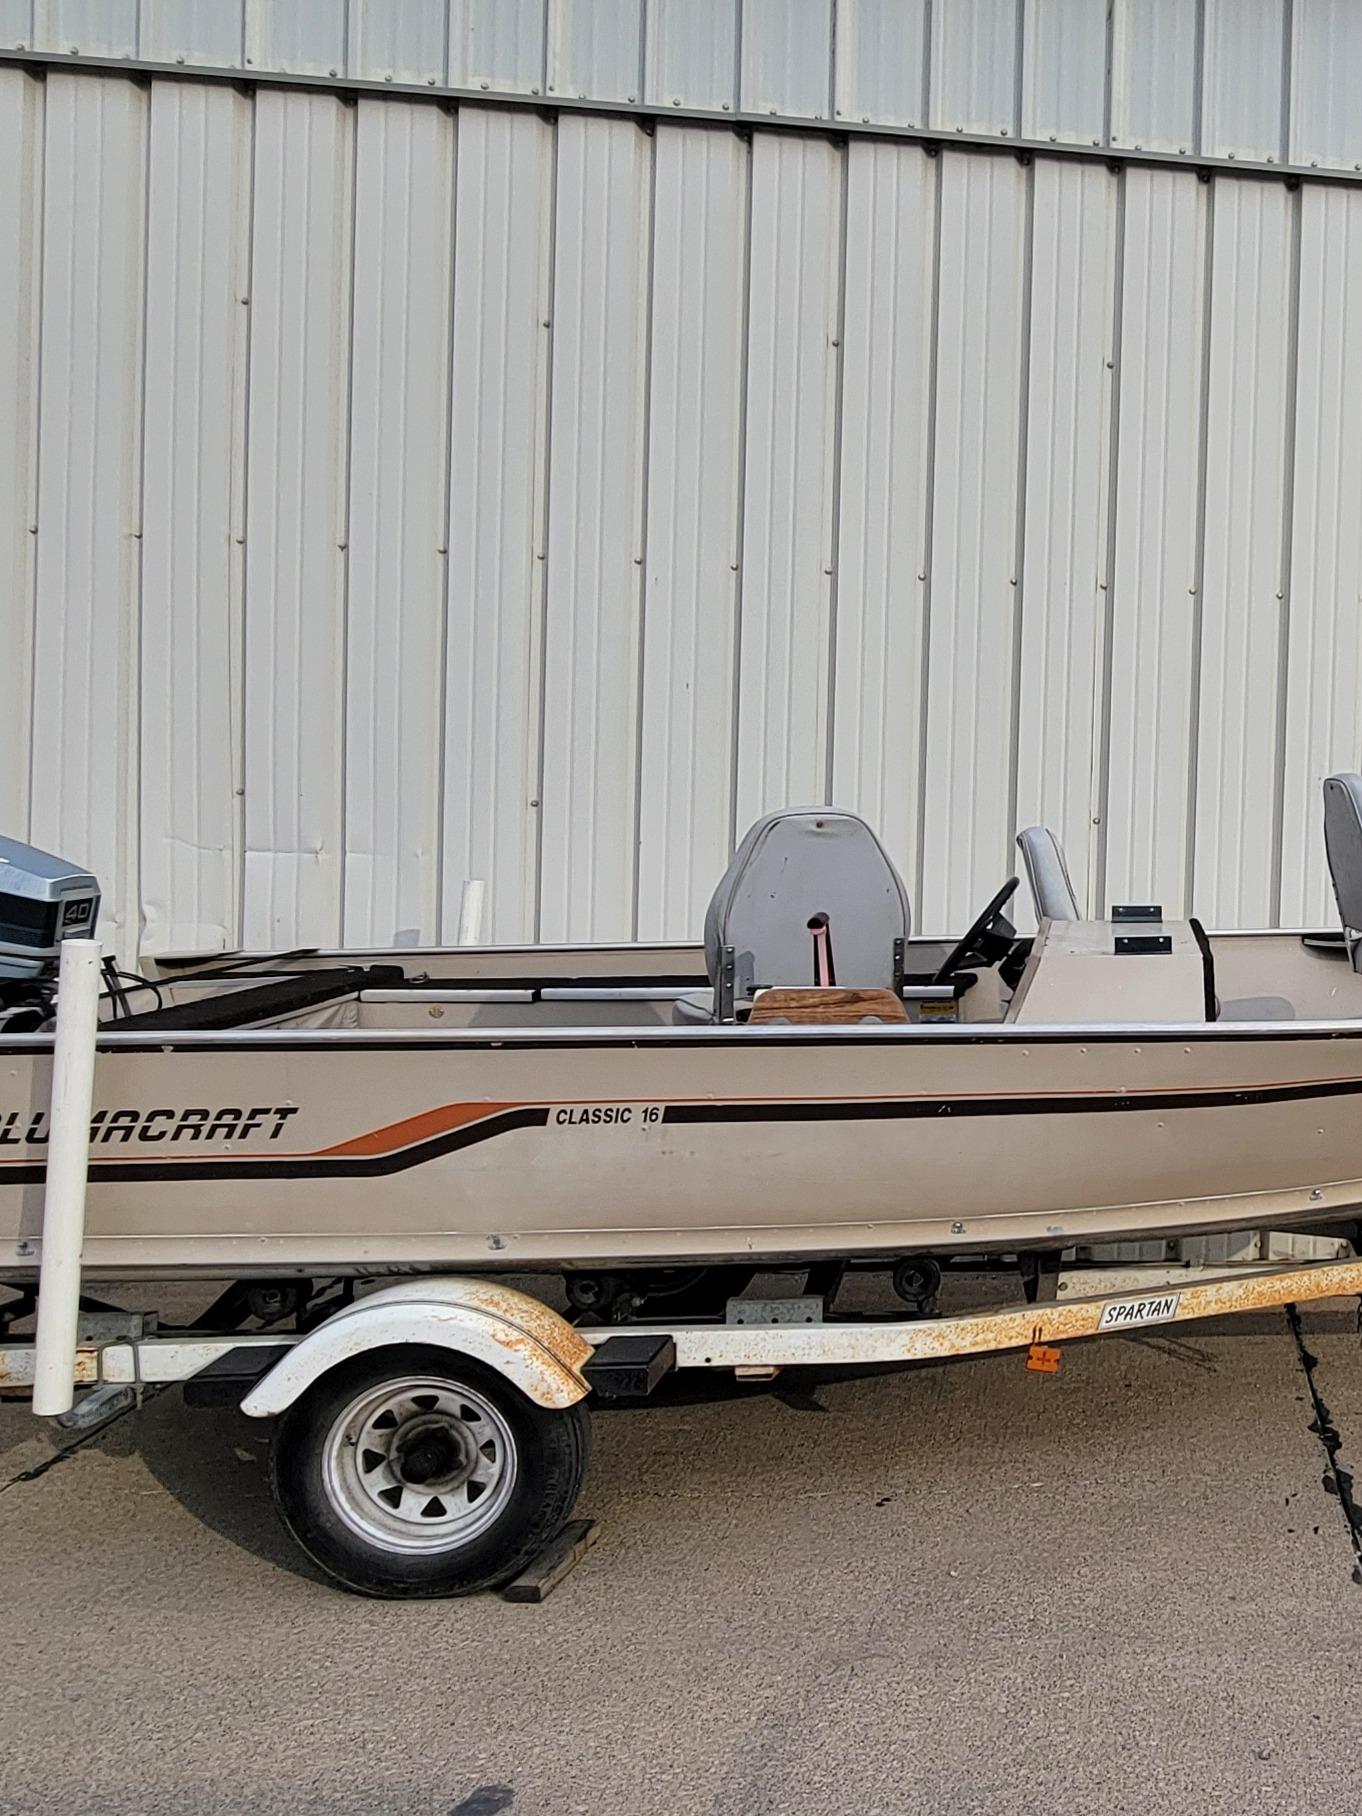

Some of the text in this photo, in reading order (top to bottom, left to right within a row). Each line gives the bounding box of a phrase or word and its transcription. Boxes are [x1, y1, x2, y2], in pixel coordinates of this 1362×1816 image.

[65, 903, 90, 920] 40
[556, 1106, 660, 1126] CLASSIC 16
[1105, 1298, 1174, 1324] SPARTAN
